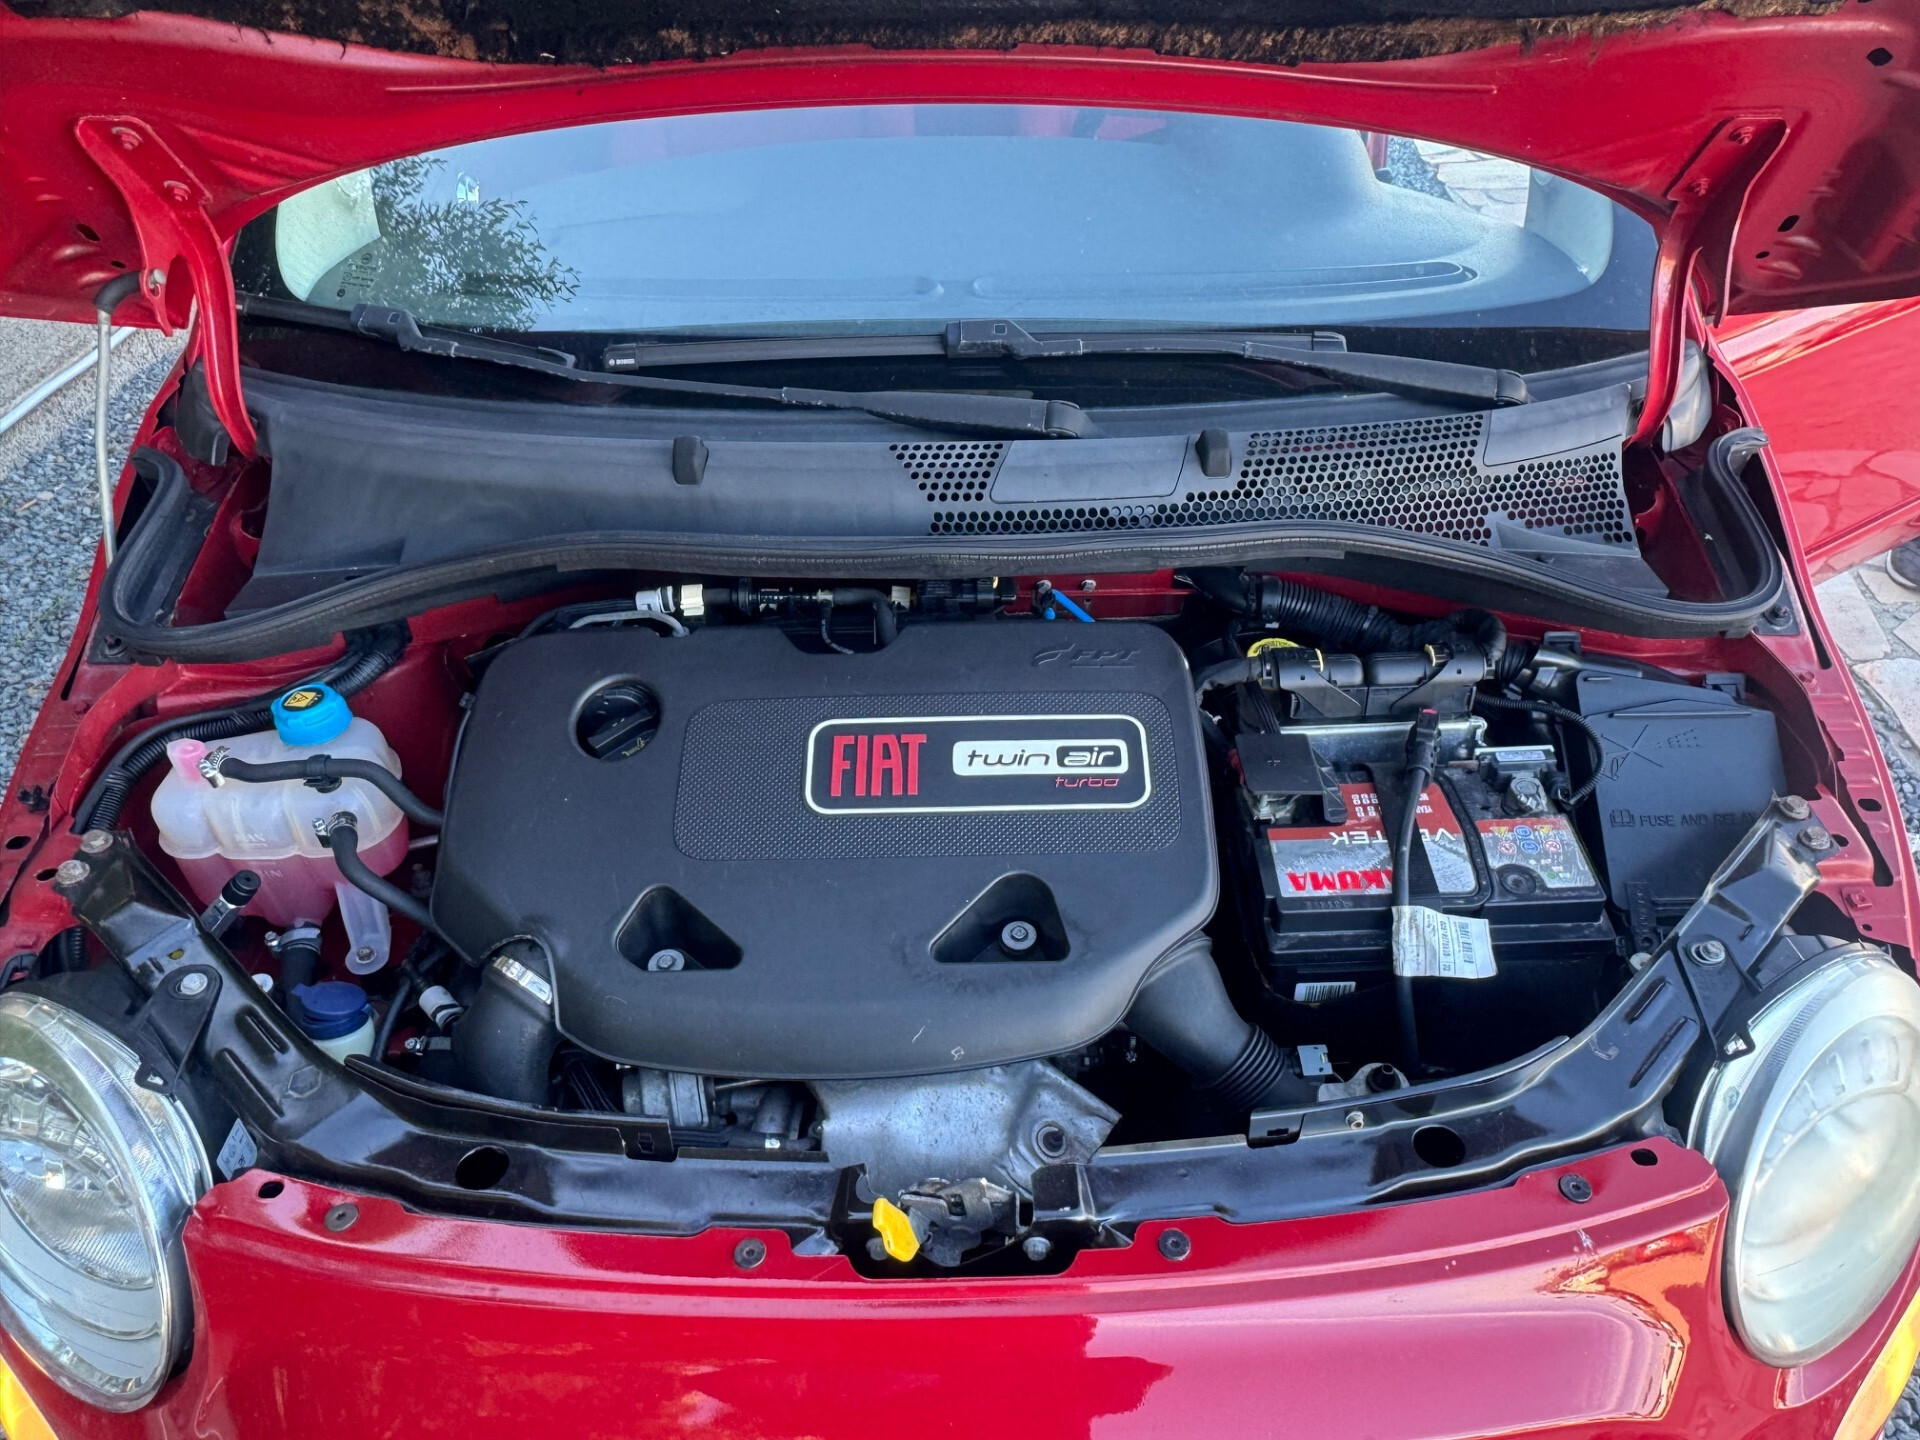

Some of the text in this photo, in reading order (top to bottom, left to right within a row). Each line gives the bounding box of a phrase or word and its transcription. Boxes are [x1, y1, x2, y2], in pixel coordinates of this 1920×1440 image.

[967, 746, 1114, 767] twin air
[830, 734, 927, 797] FIAT
[1055, 776, 1120, 788] turbo
[1639, 815, 1675, 827] FUSE
[1681, 814, 1708, 826] AND
